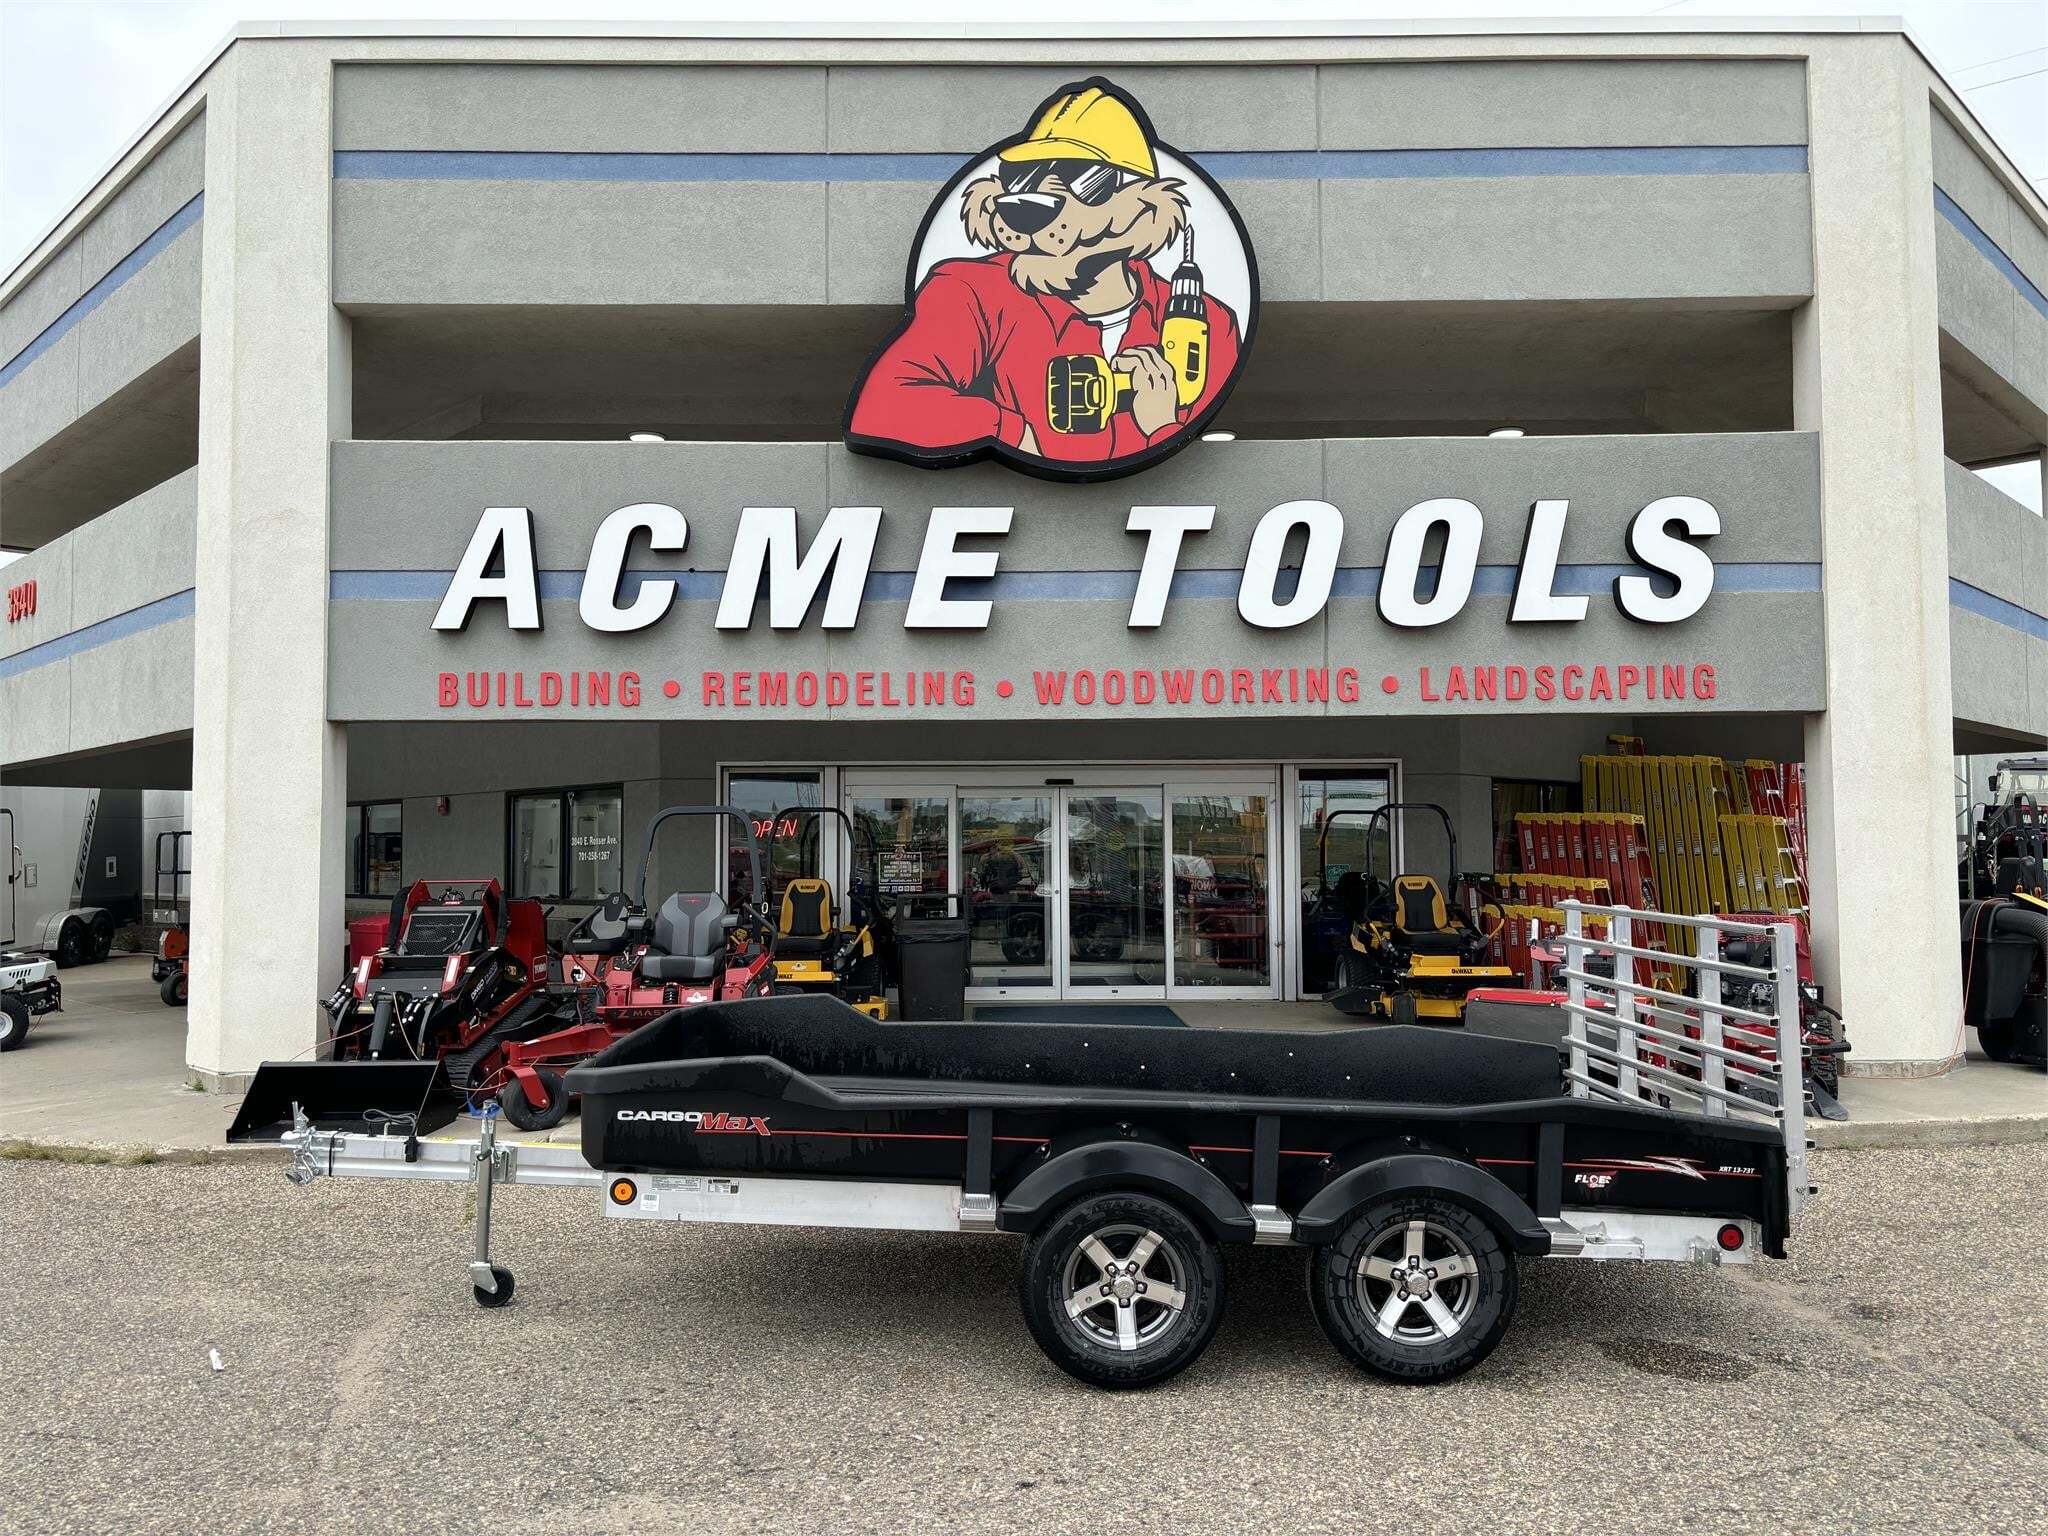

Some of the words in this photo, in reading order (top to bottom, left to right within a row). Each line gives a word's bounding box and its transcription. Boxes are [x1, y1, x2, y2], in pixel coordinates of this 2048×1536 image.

[431, 503, 1015, 633] ACME
[1125, 496, 1722, 629] TOOLS
[6, 578, 38, 622] 3840
[438, 671, 641, 708] BUILDING
[703, 671, 975, 707] REMODELING
[1034, 667, 1360, 706] WOODWORKING
[1421, 663, 1716, 702] LANDSCAPING
[76, 798, 96, 890] LEGEND
